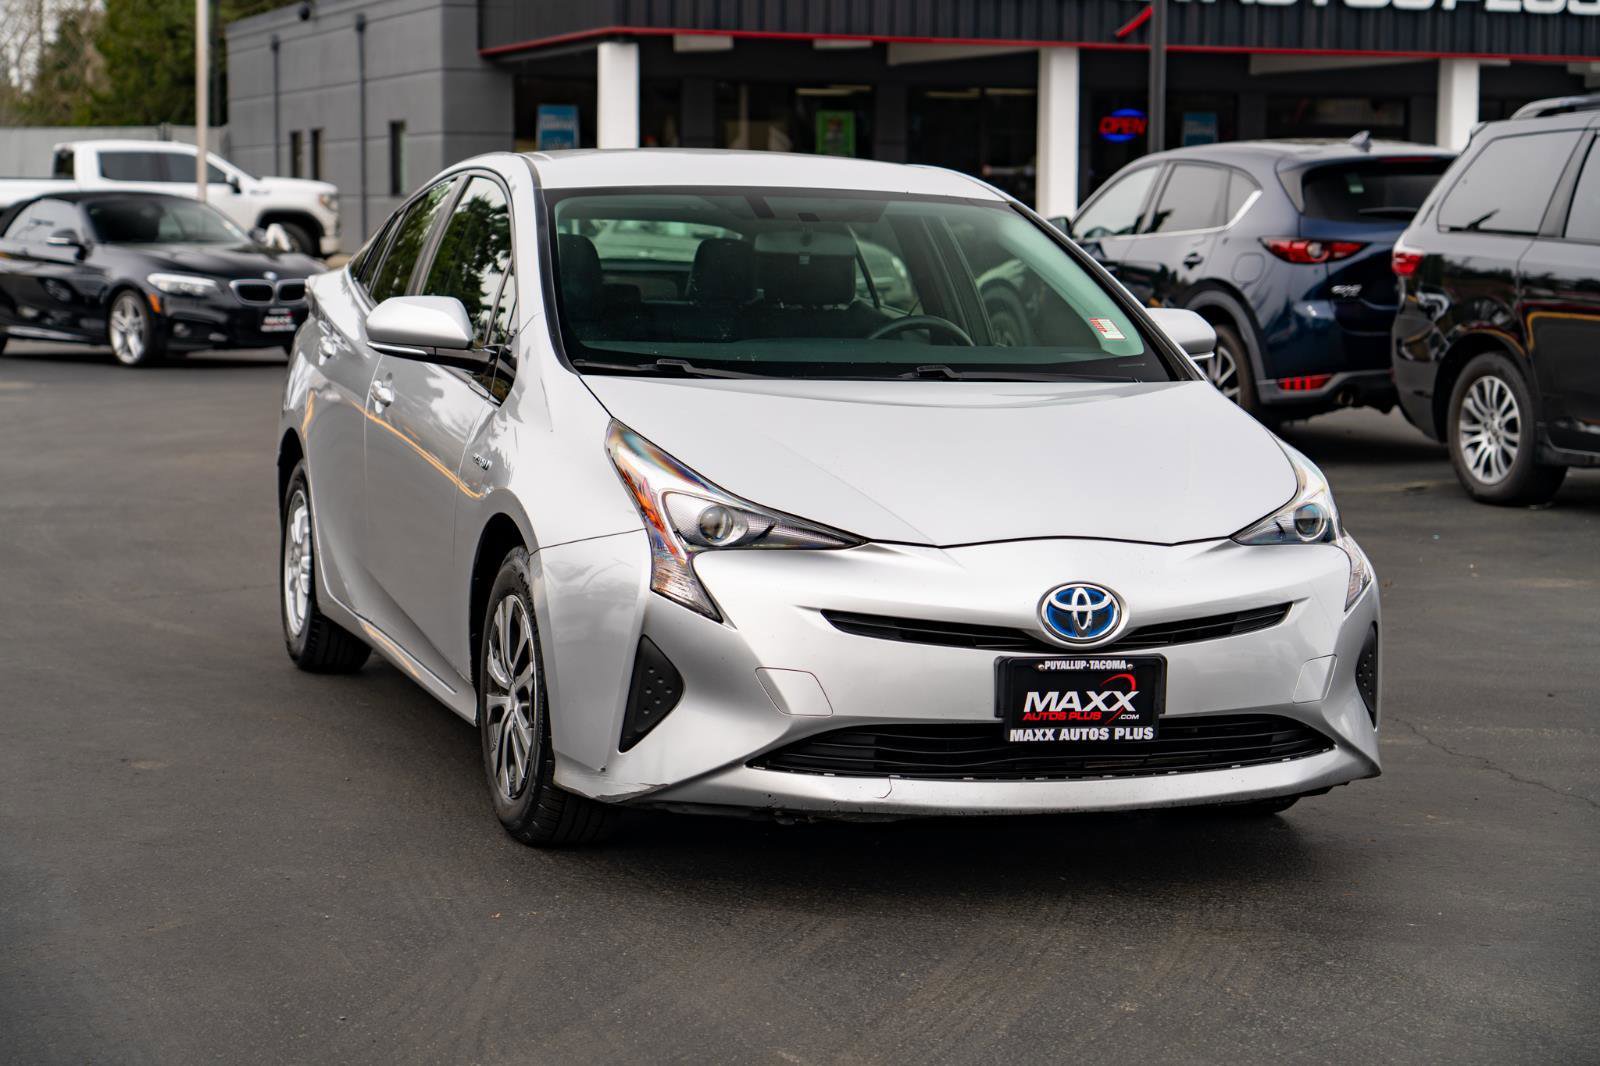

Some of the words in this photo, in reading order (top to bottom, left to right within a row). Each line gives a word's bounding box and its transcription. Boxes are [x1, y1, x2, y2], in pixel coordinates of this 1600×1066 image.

[1024, 690, 1139, 713] MAXX
[1023, 712, 1067, 721] AUTOS
[1068, 711, 1103, 721] PLUS
[1009, 729, 1055, 742] MAXX
[1058, 728, 1109, 741] AUTOS
[1115, 727, 1154, 741] PLUS
